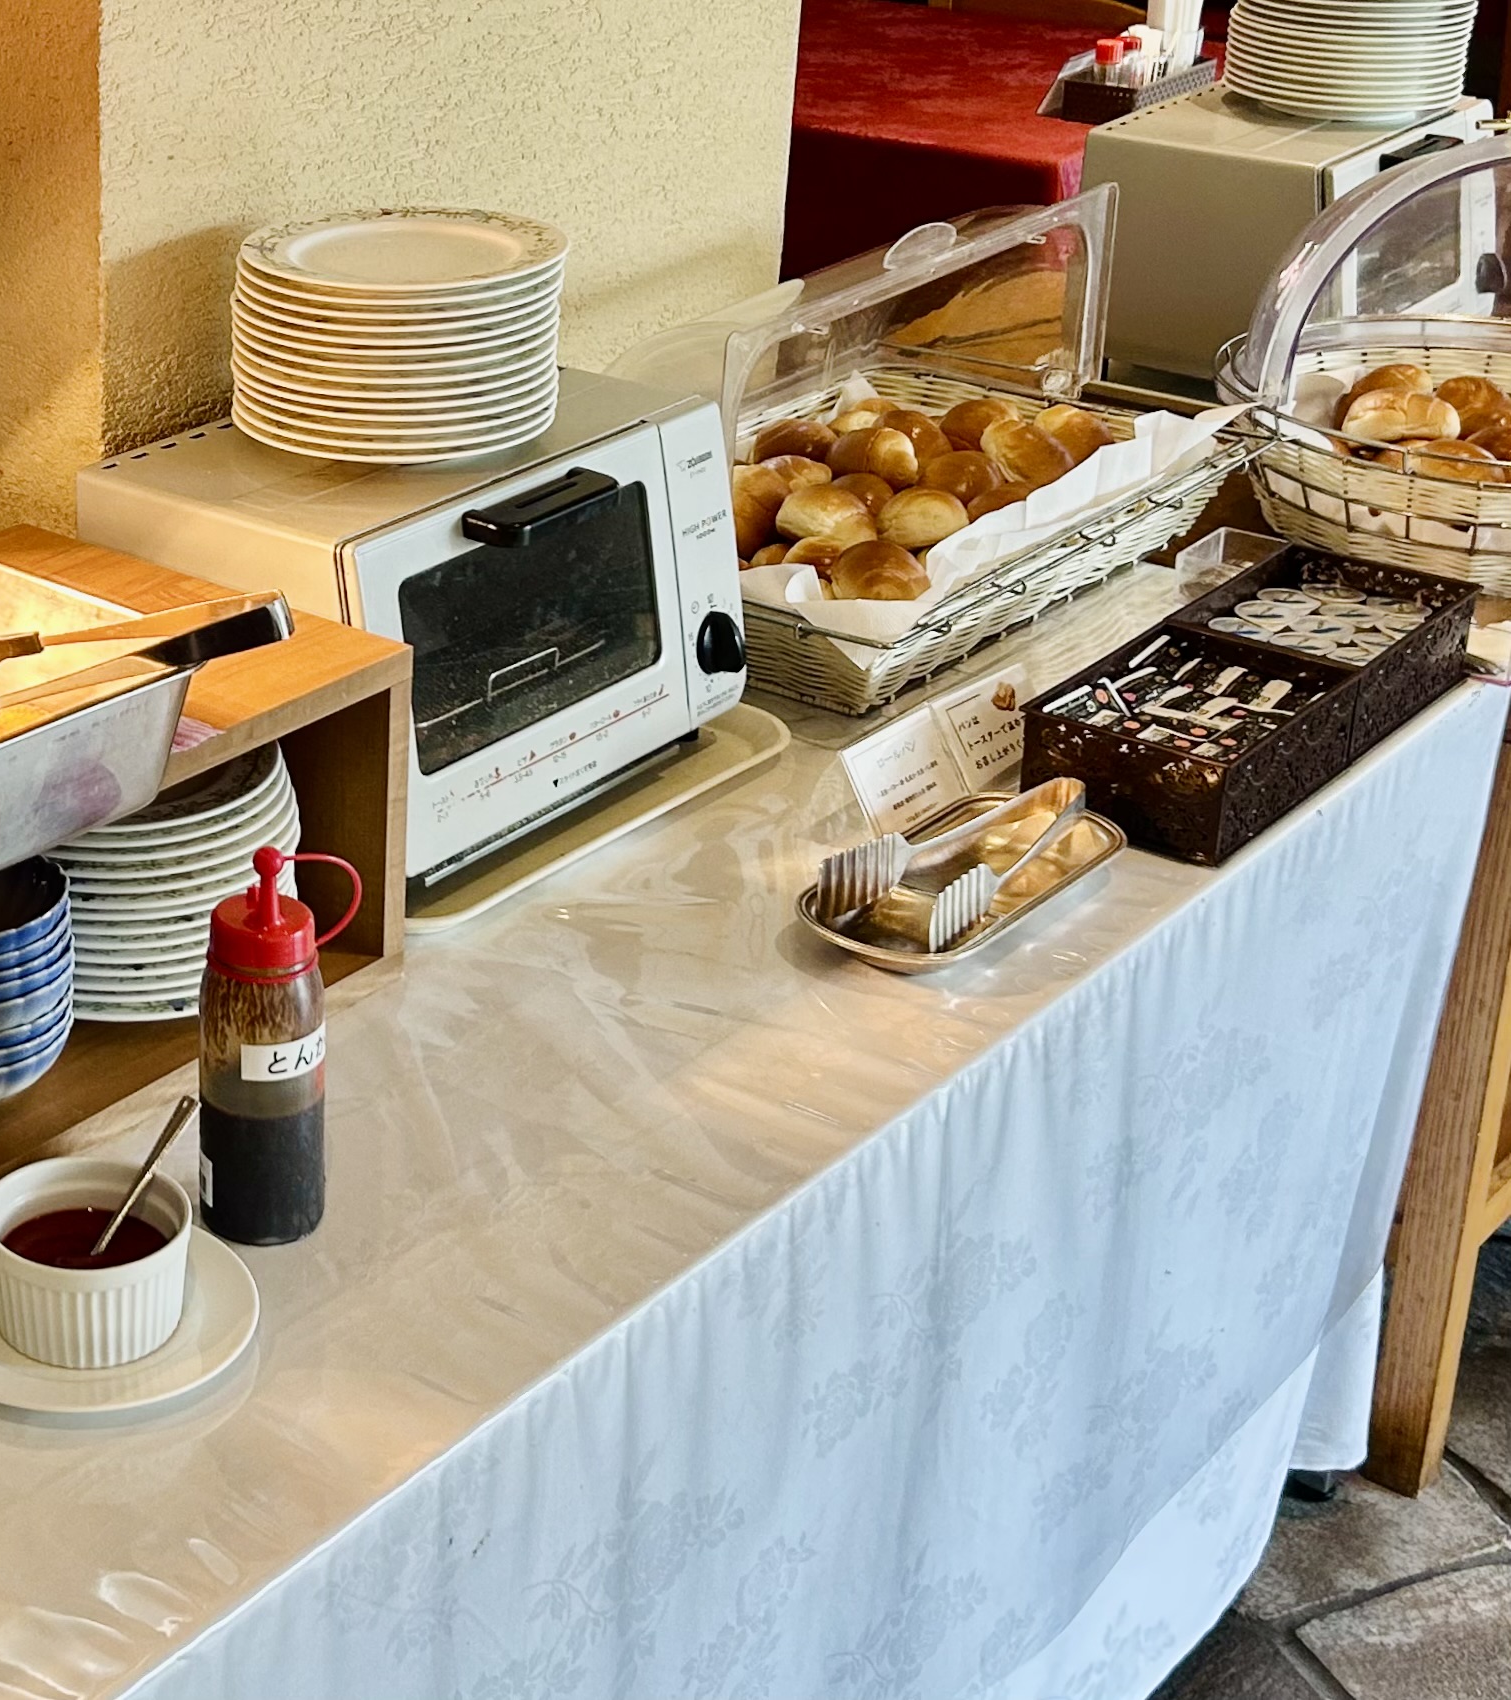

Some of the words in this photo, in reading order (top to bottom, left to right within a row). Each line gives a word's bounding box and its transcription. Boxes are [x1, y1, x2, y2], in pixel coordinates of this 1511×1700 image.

[701, 509, 727, 528] POWER
[876, 739, 917, 769] ロールパン
[975, 738, 1025, 769] お召し上がりく
